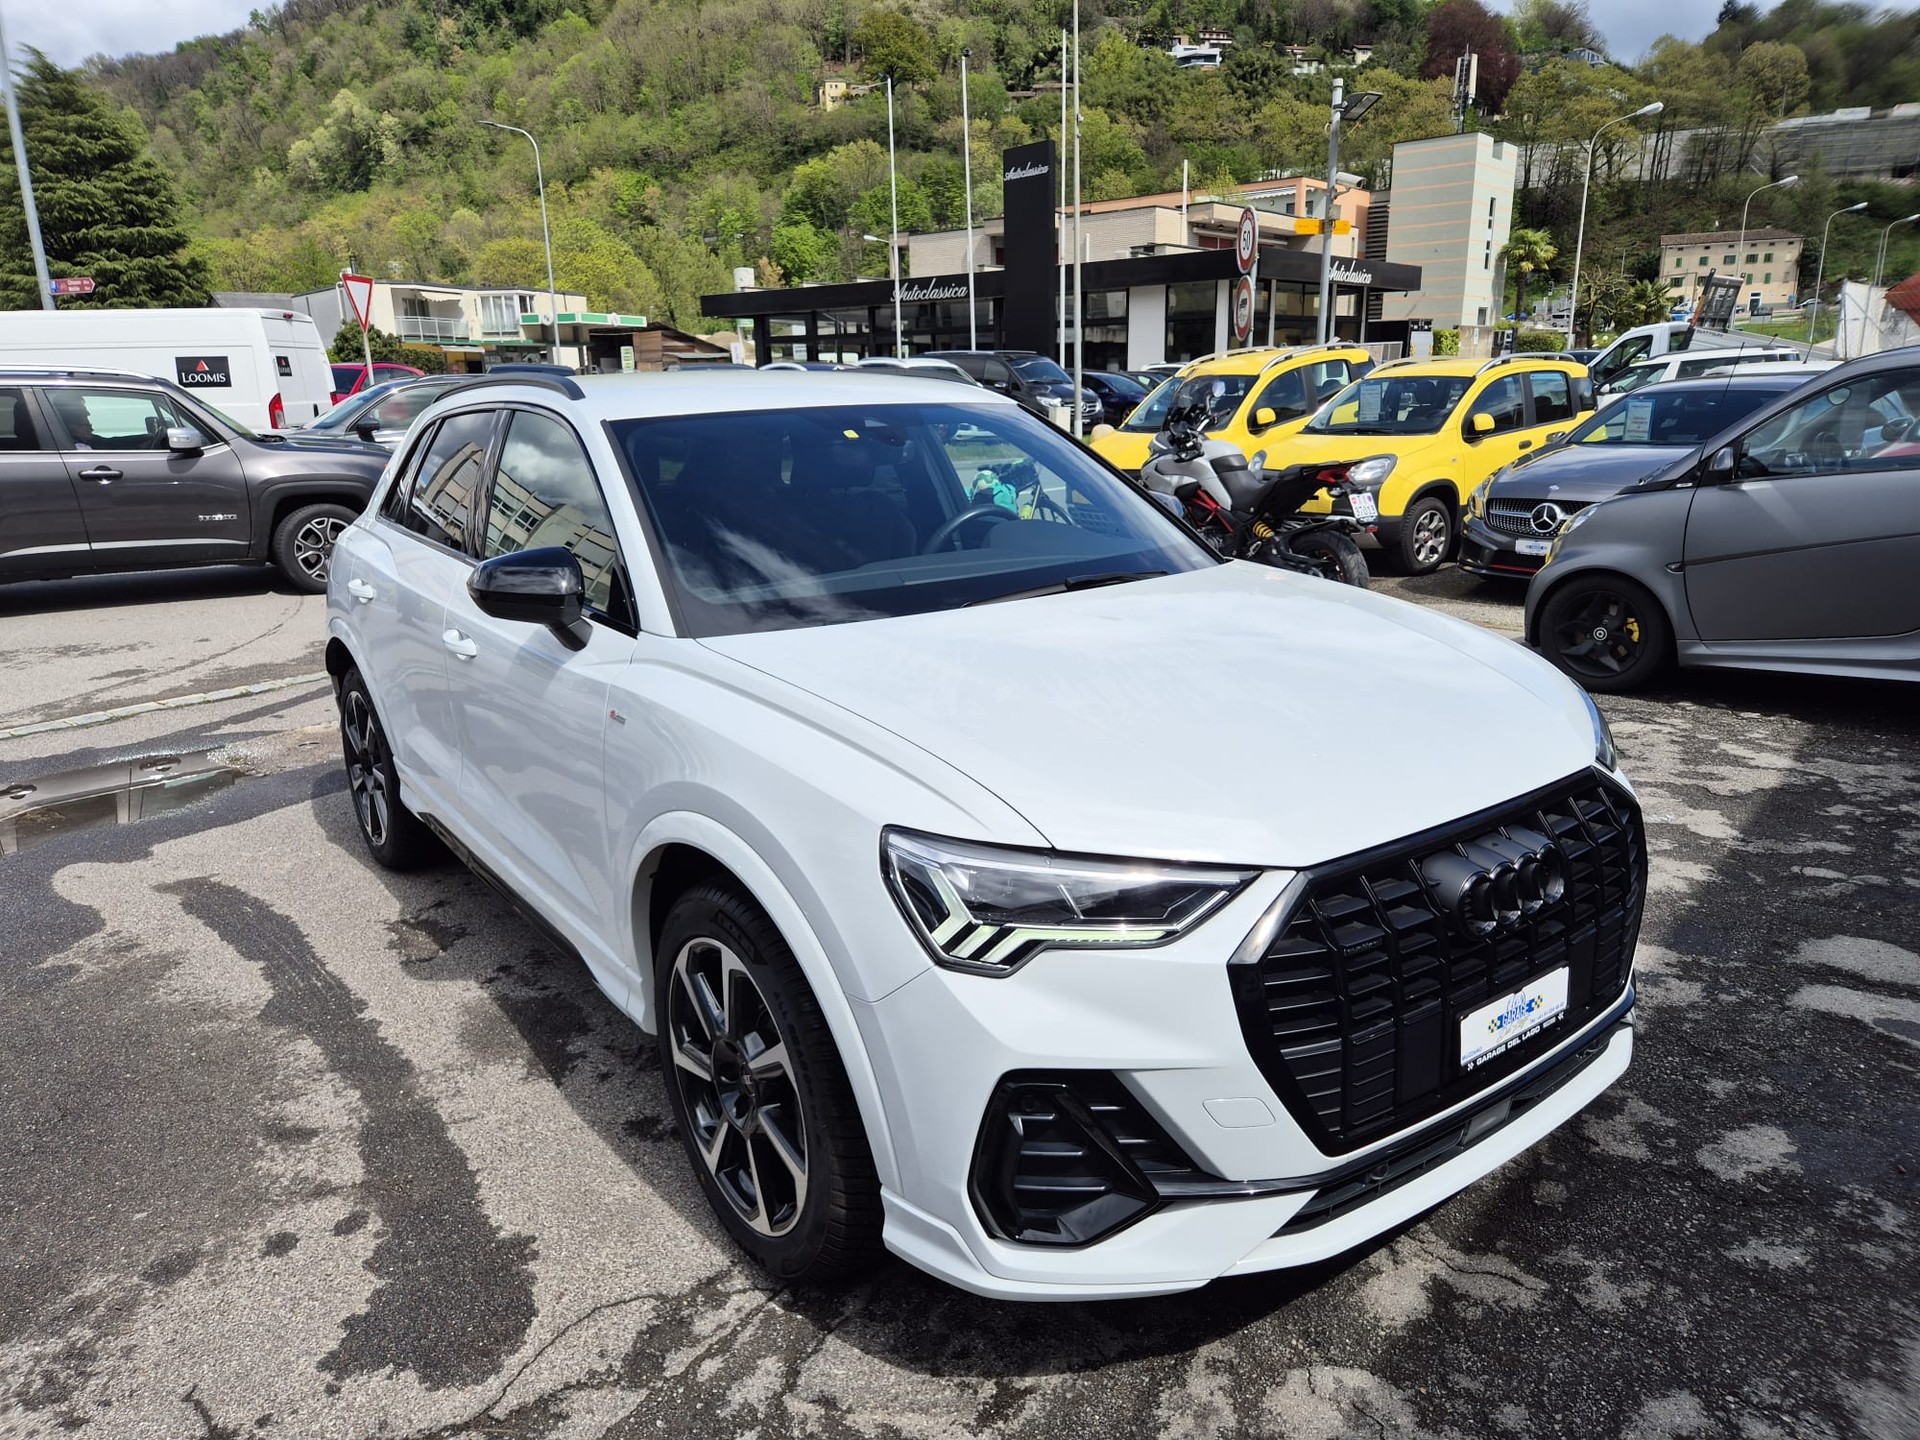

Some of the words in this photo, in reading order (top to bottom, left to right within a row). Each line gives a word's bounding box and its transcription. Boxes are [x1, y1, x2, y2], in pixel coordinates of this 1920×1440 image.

[1242, 230, 1251, 251] 50
[890, 278, 968, 302] Autoclassica
[181, 372, 226, 383] LOOMIS
[1476, 1044, 1506, 1066] GARAGE
[1507, 1036, 1522, 1050] DEL
[1522, 1025, 1541, 1041] LAGO
